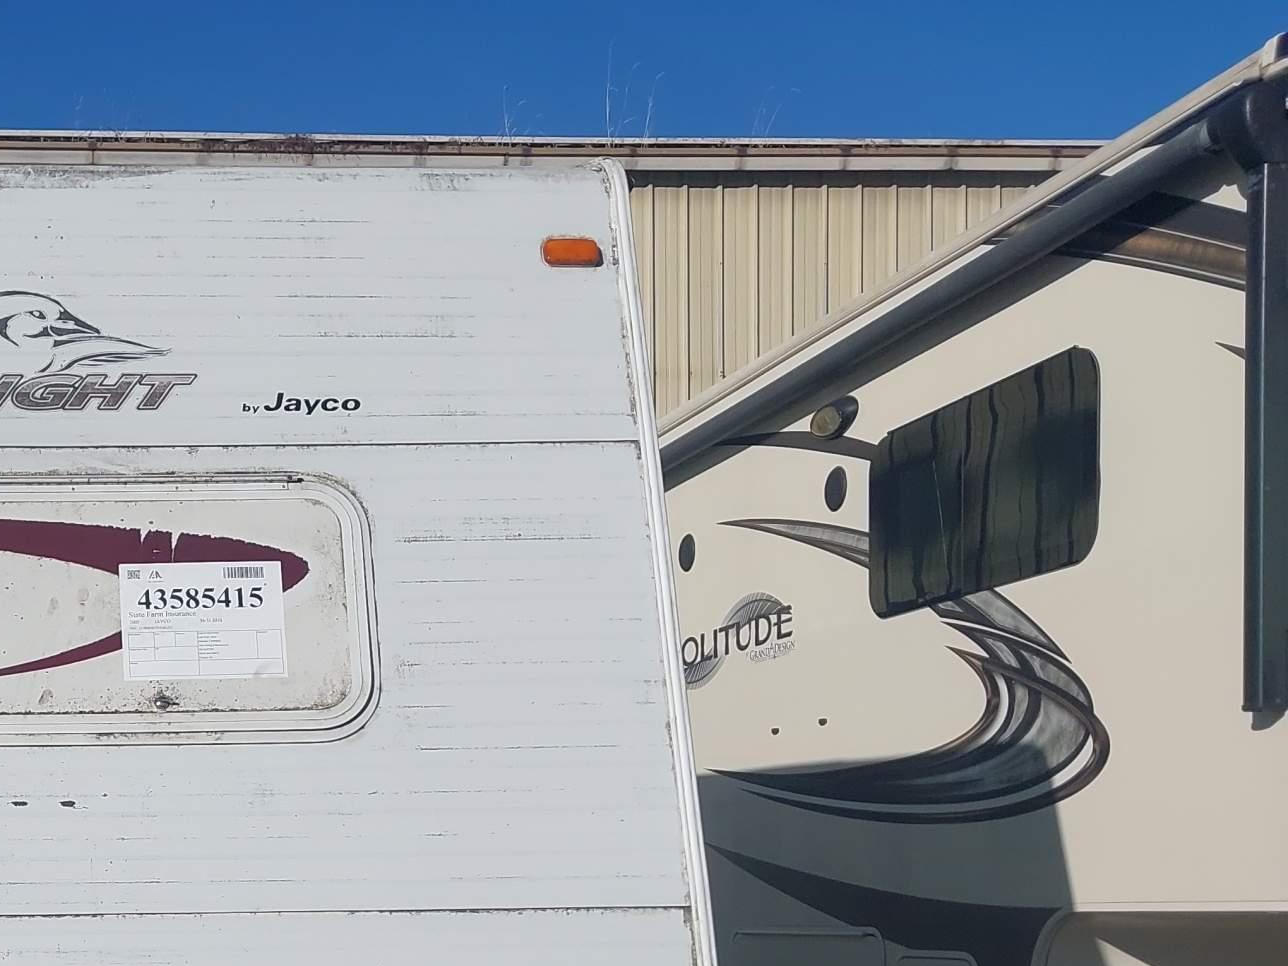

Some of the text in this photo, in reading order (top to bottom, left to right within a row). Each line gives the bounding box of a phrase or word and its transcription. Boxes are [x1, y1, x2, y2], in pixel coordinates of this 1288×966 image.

[242, 392, 361, 416] by Jayco
[137, 586, 264, 610] 43585415
[681, 604, 793, 669] OLITUDE
